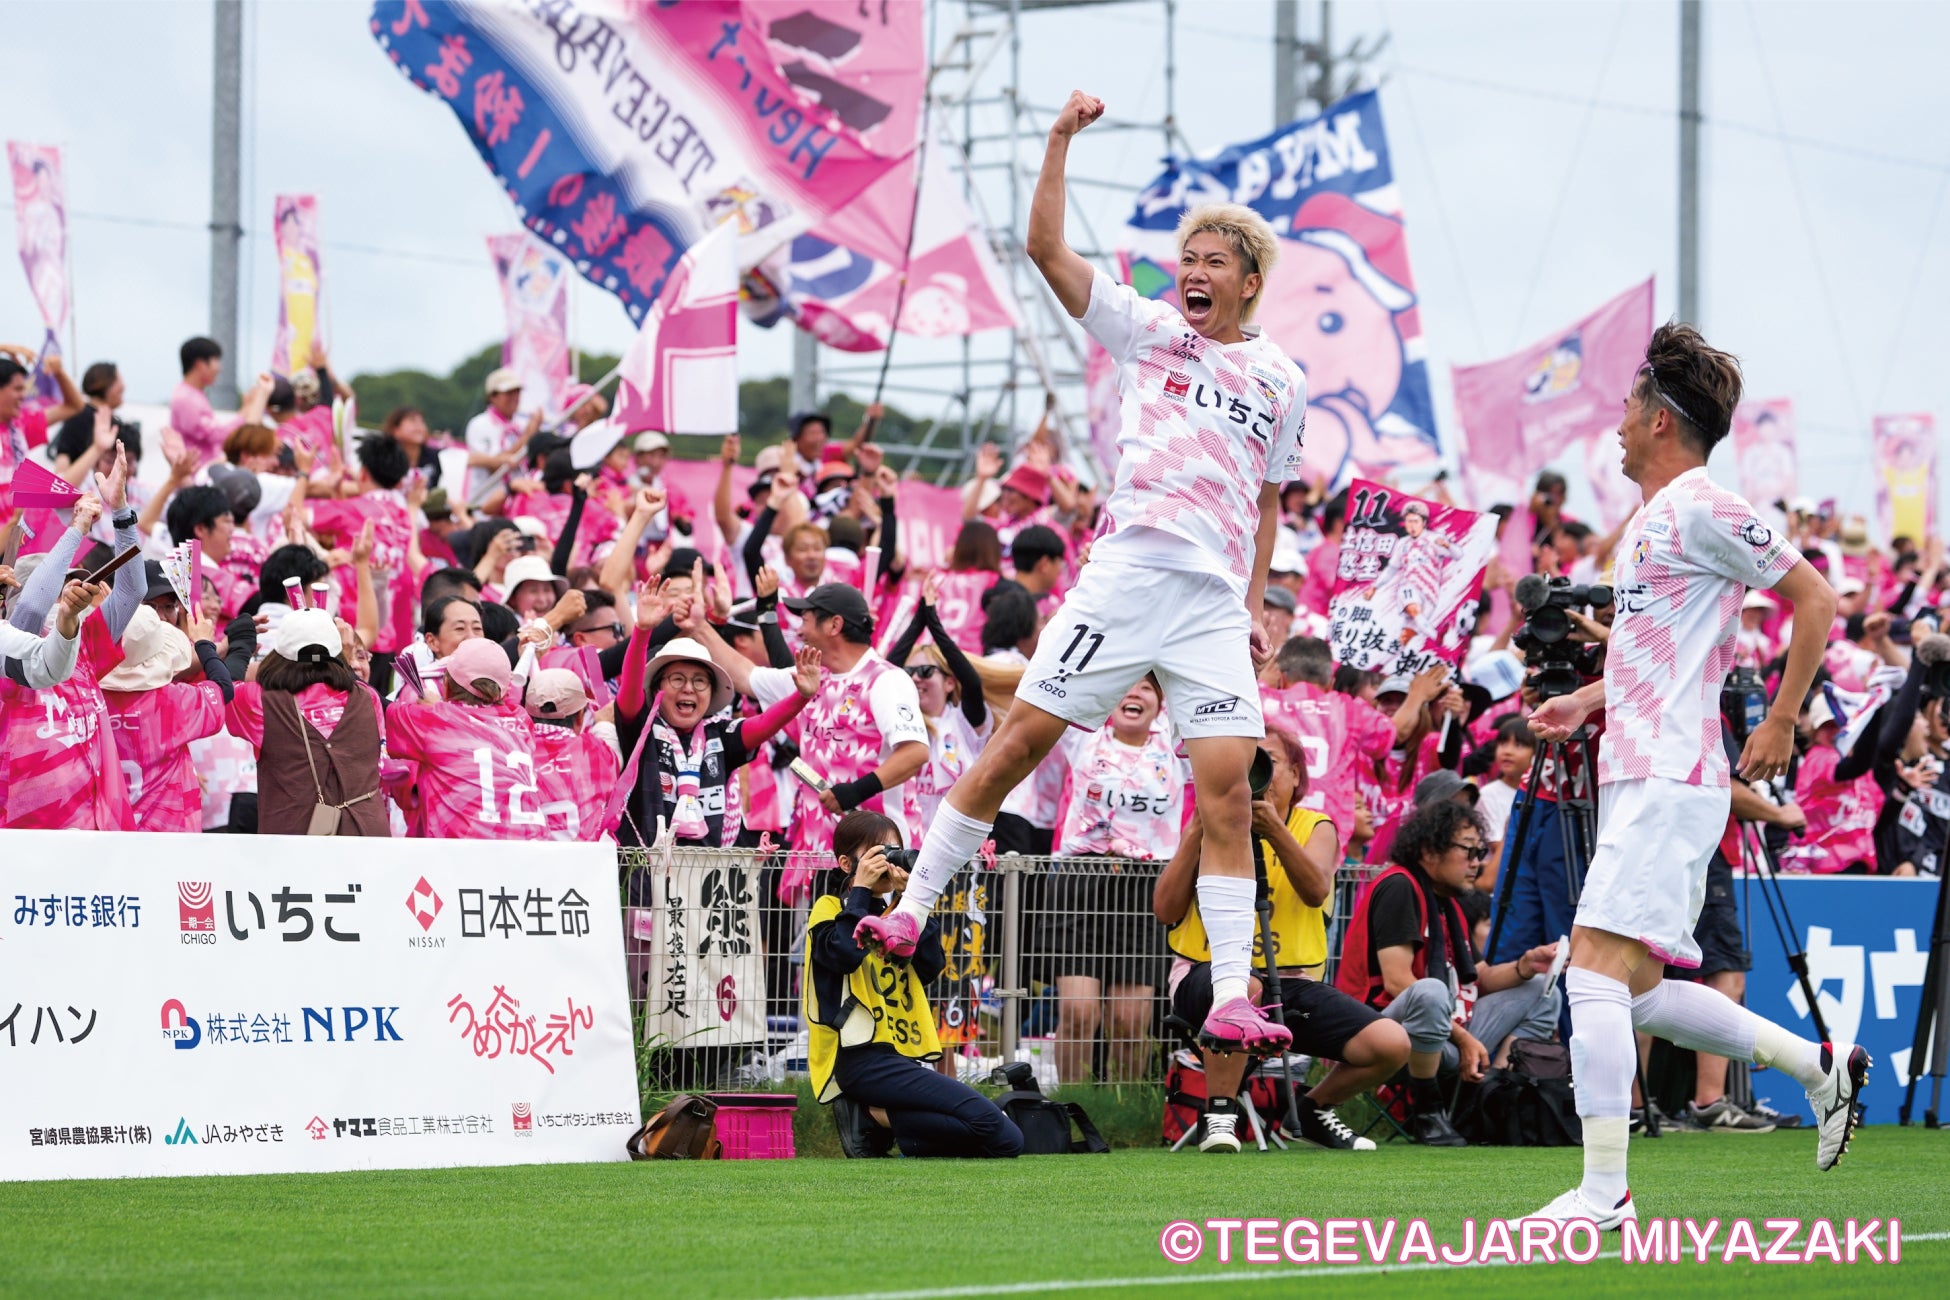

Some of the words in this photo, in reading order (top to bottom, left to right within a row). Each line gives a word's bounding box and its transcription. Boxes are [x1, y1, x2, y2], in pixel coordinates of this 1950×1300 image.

[1173, 349, 1201, 363] ZOZO
[1351, 488, 1390, 526] 11
[1059, 624, 1105, 673] 11
[1038, 680, 1067, 699] ZOZO
[1197, 699, 1236, 714] MTG
[473, 747, 546, 826] 12
[1107, 789, 1170, 815] いちご
[14, 894, 141, 929] みずほ銀行
[181, 916, 214, 929] 一期一会
[225, 884, 362, 942] いちご
[458, 887, 590, 939] 日本生命
[181, 933, 216, 944] ICHIGO
[409, 937, 445, 948] NISSAY
[716, 975, 737, 1022] 6
[946, 995, 965, 1027] 6
[207, 1013, 294, 1044] 株式会社
[302, 1006, 404, 1042] NPK
[29, 1124, 152, 1147] 宮崎県農協果汁(株)
[202, 1123, 284, 1145] JAみやざき
[333, 1115, 494, 1138] ヤマエ食品工業株式会社
